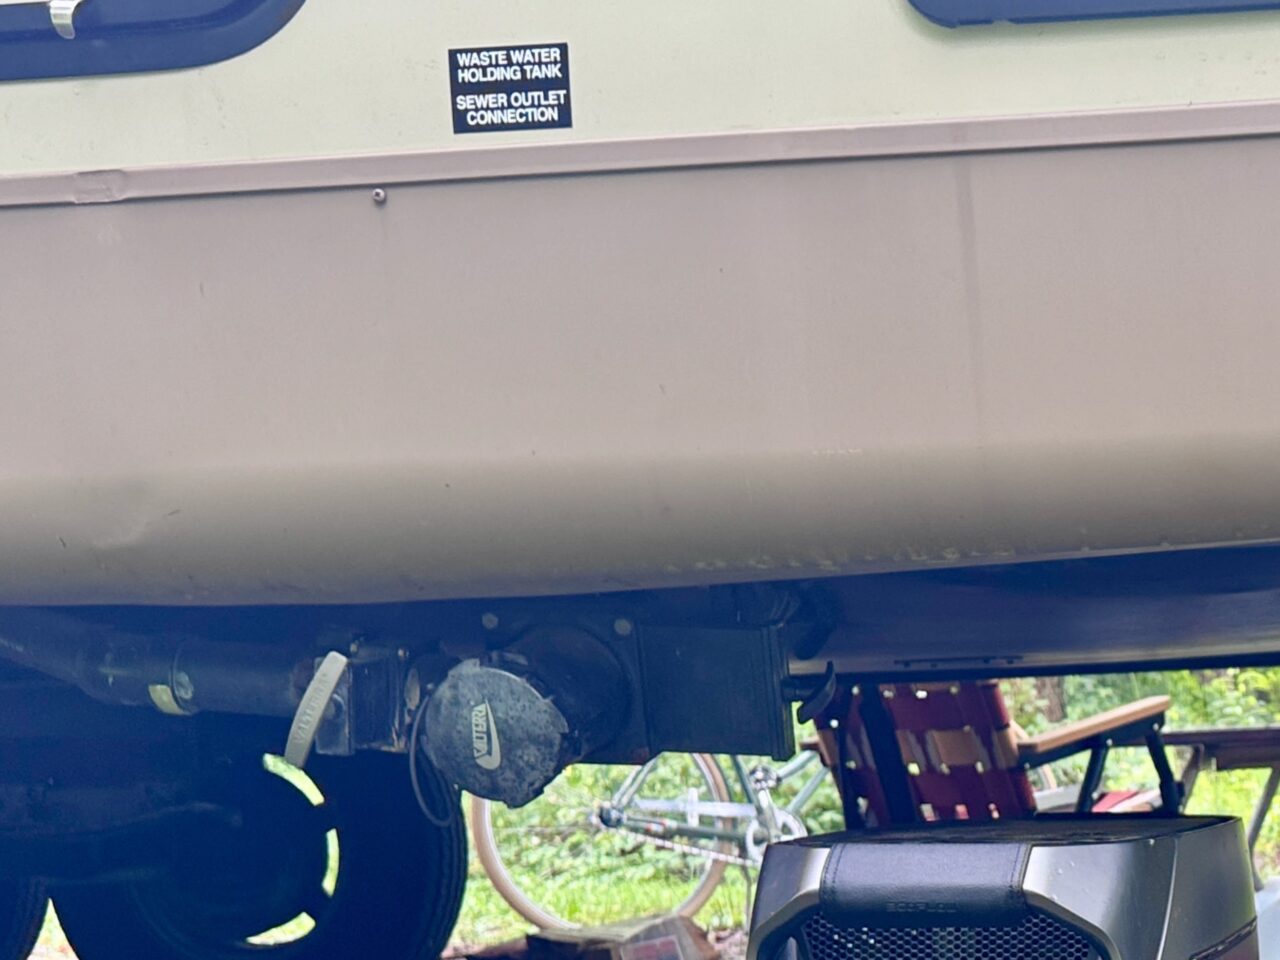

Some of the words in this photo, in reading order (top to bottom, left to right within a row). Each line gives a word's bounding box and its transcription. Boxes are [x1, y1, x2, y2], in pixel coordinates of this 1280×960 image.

[457, 51, 507, 67] WASTE
[510, 48, 561, 63] WATER
[458, 66, 521, 82] HOLDING
[523, 63, 562, 79] TANK
[456, 93, 507, 110] SEWER
[510, 90, 567, 107] OUTLET
[466, 107, 558, 125] CONNECTION
